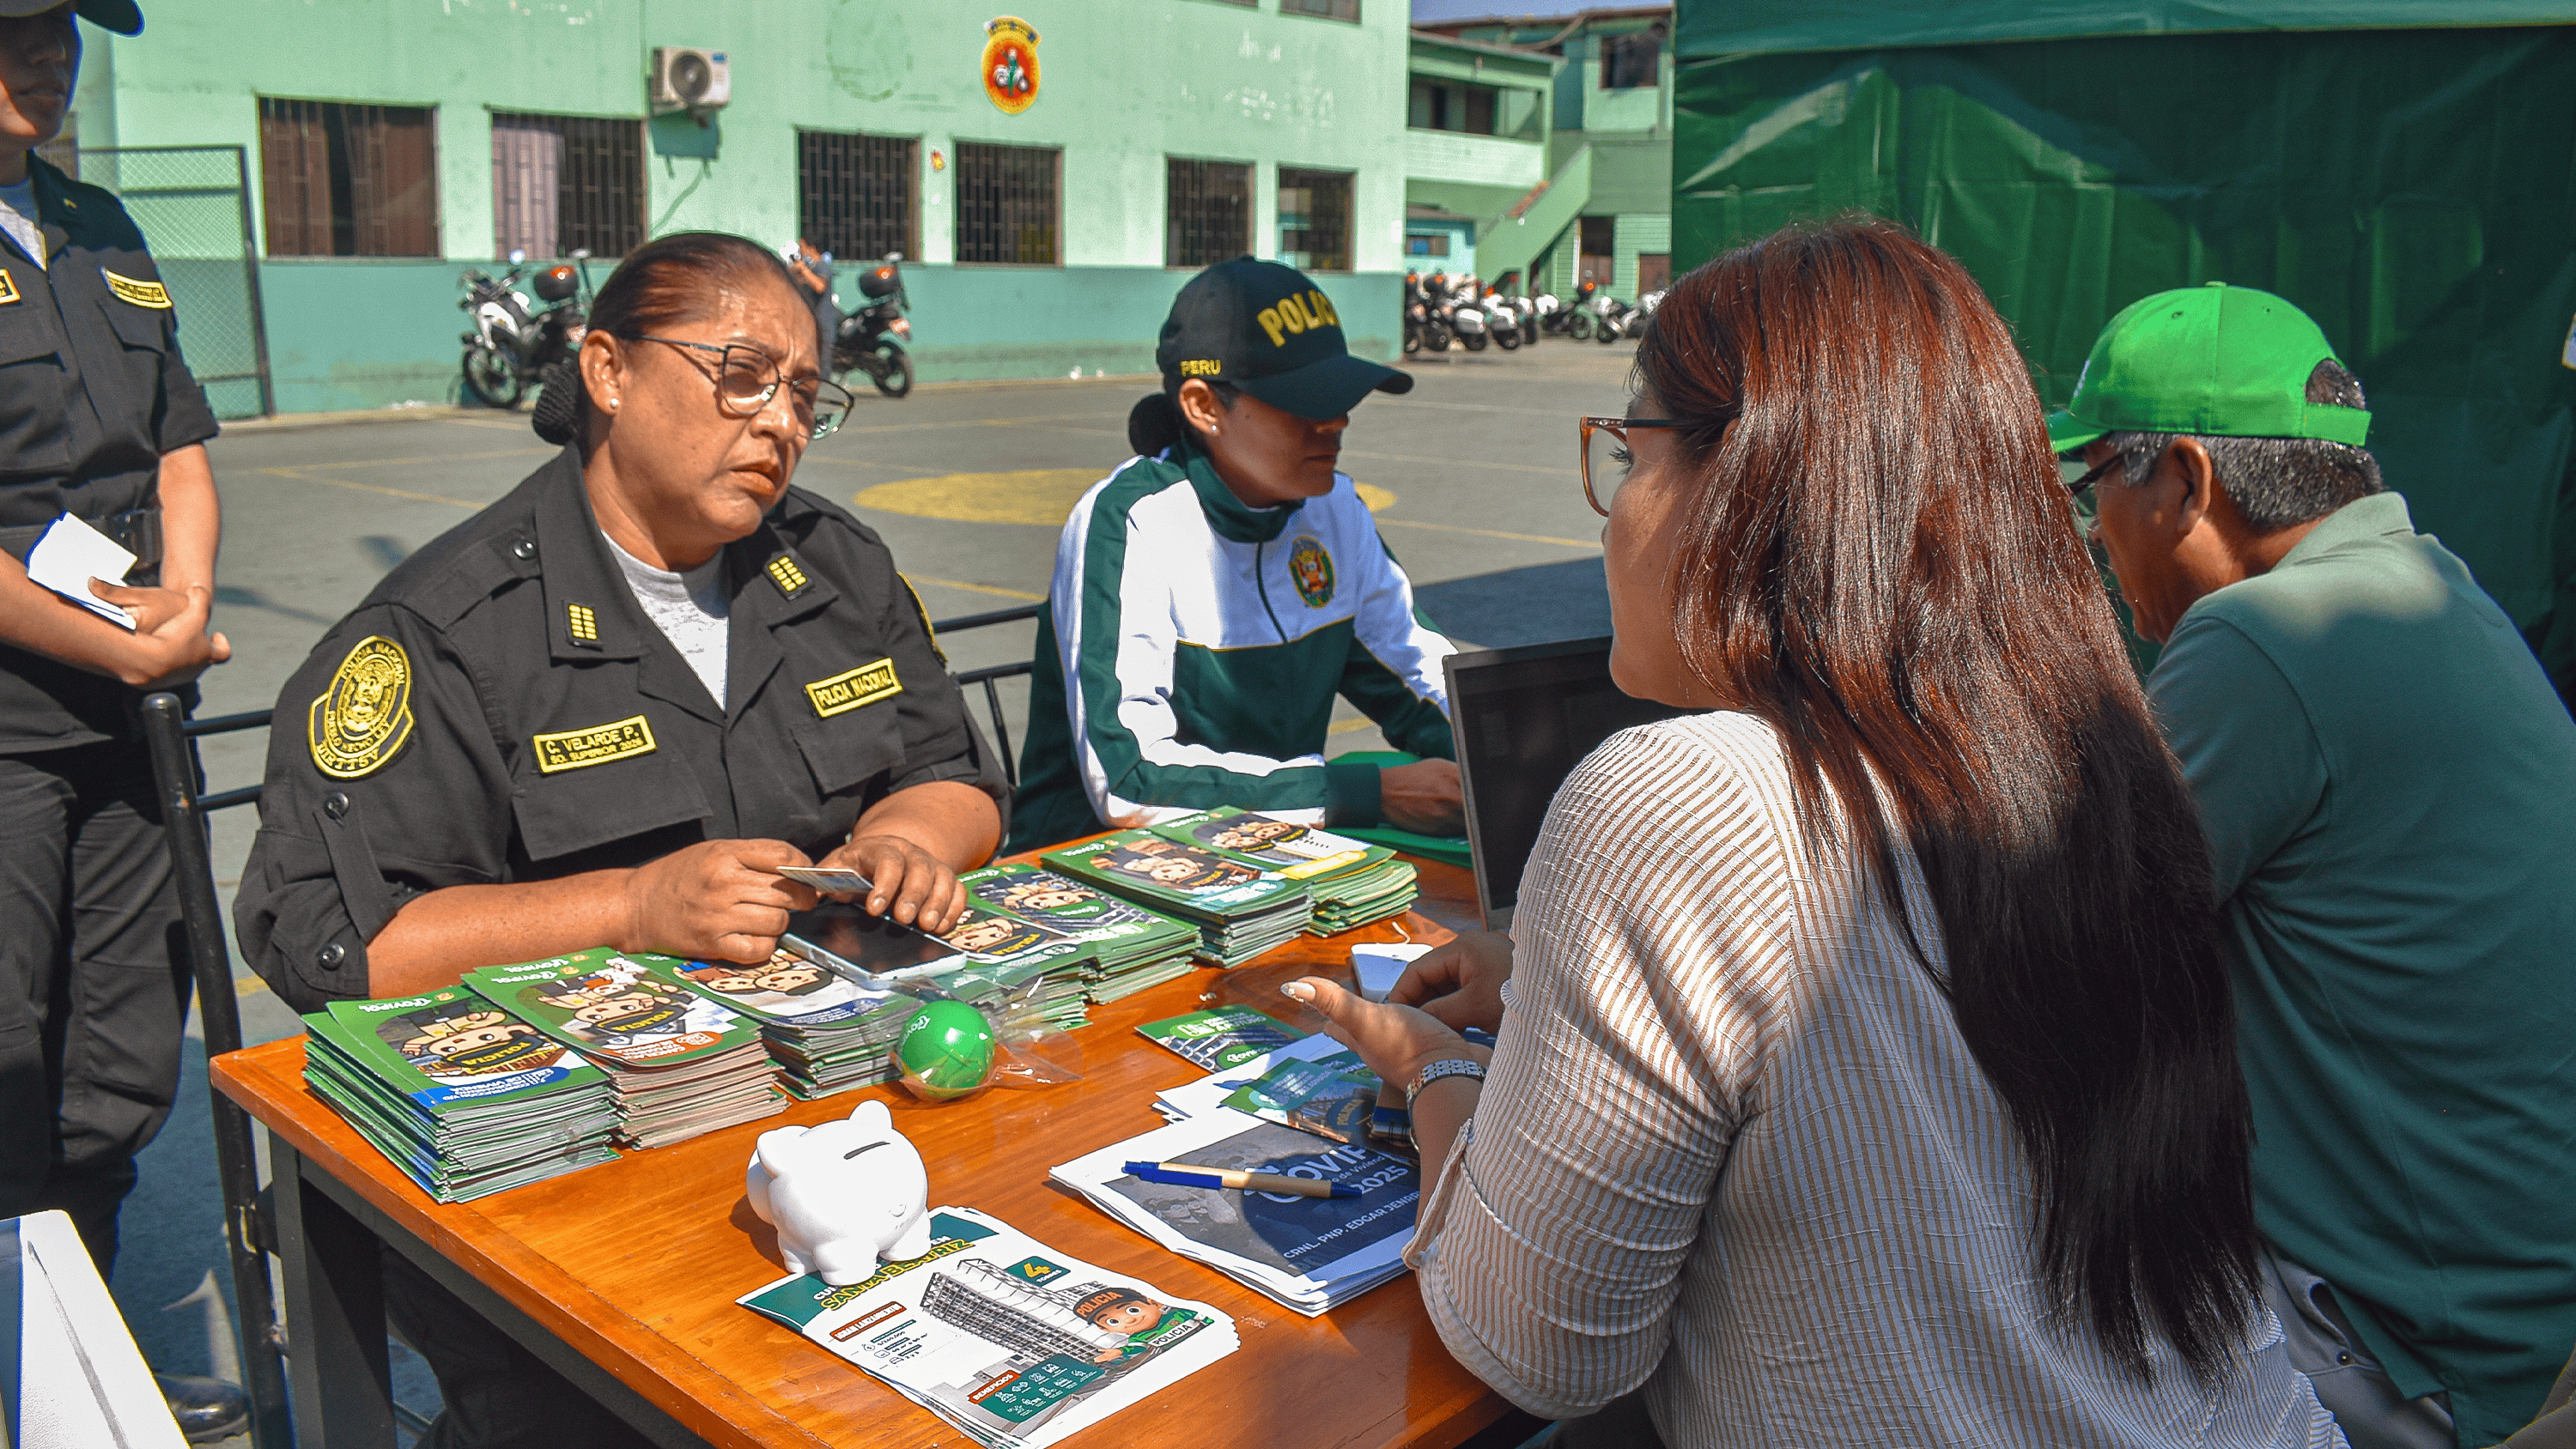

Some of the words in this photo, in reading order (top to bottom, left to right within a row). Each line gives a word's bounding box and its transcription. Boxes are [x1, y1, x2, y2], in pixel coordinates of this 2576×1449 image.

[1181, 359, 1221, 377] PERU
[545, 740, 562, 754] C.
[562, 730, 623, 752] VELARDE
[623, 726, 640, 739] P.
[569, 744, 618, 761] SUPERIOR
[461, 1041, 533, 1065] POLICIA
[1349, 1165, 1408, 1195] 2025
[1283, 1240, 1321, 1259] CRNL.
[1346, 1208, 1387, 1230] EDGAR
[1024, 1263, 1051, 1278] 4
[1076, 1291, 1123, 1318] POLICIA
[1154, 1323, 1194, 1346] POLICIA
[972, 1373, 1014, 1401] BENEFICIOS
